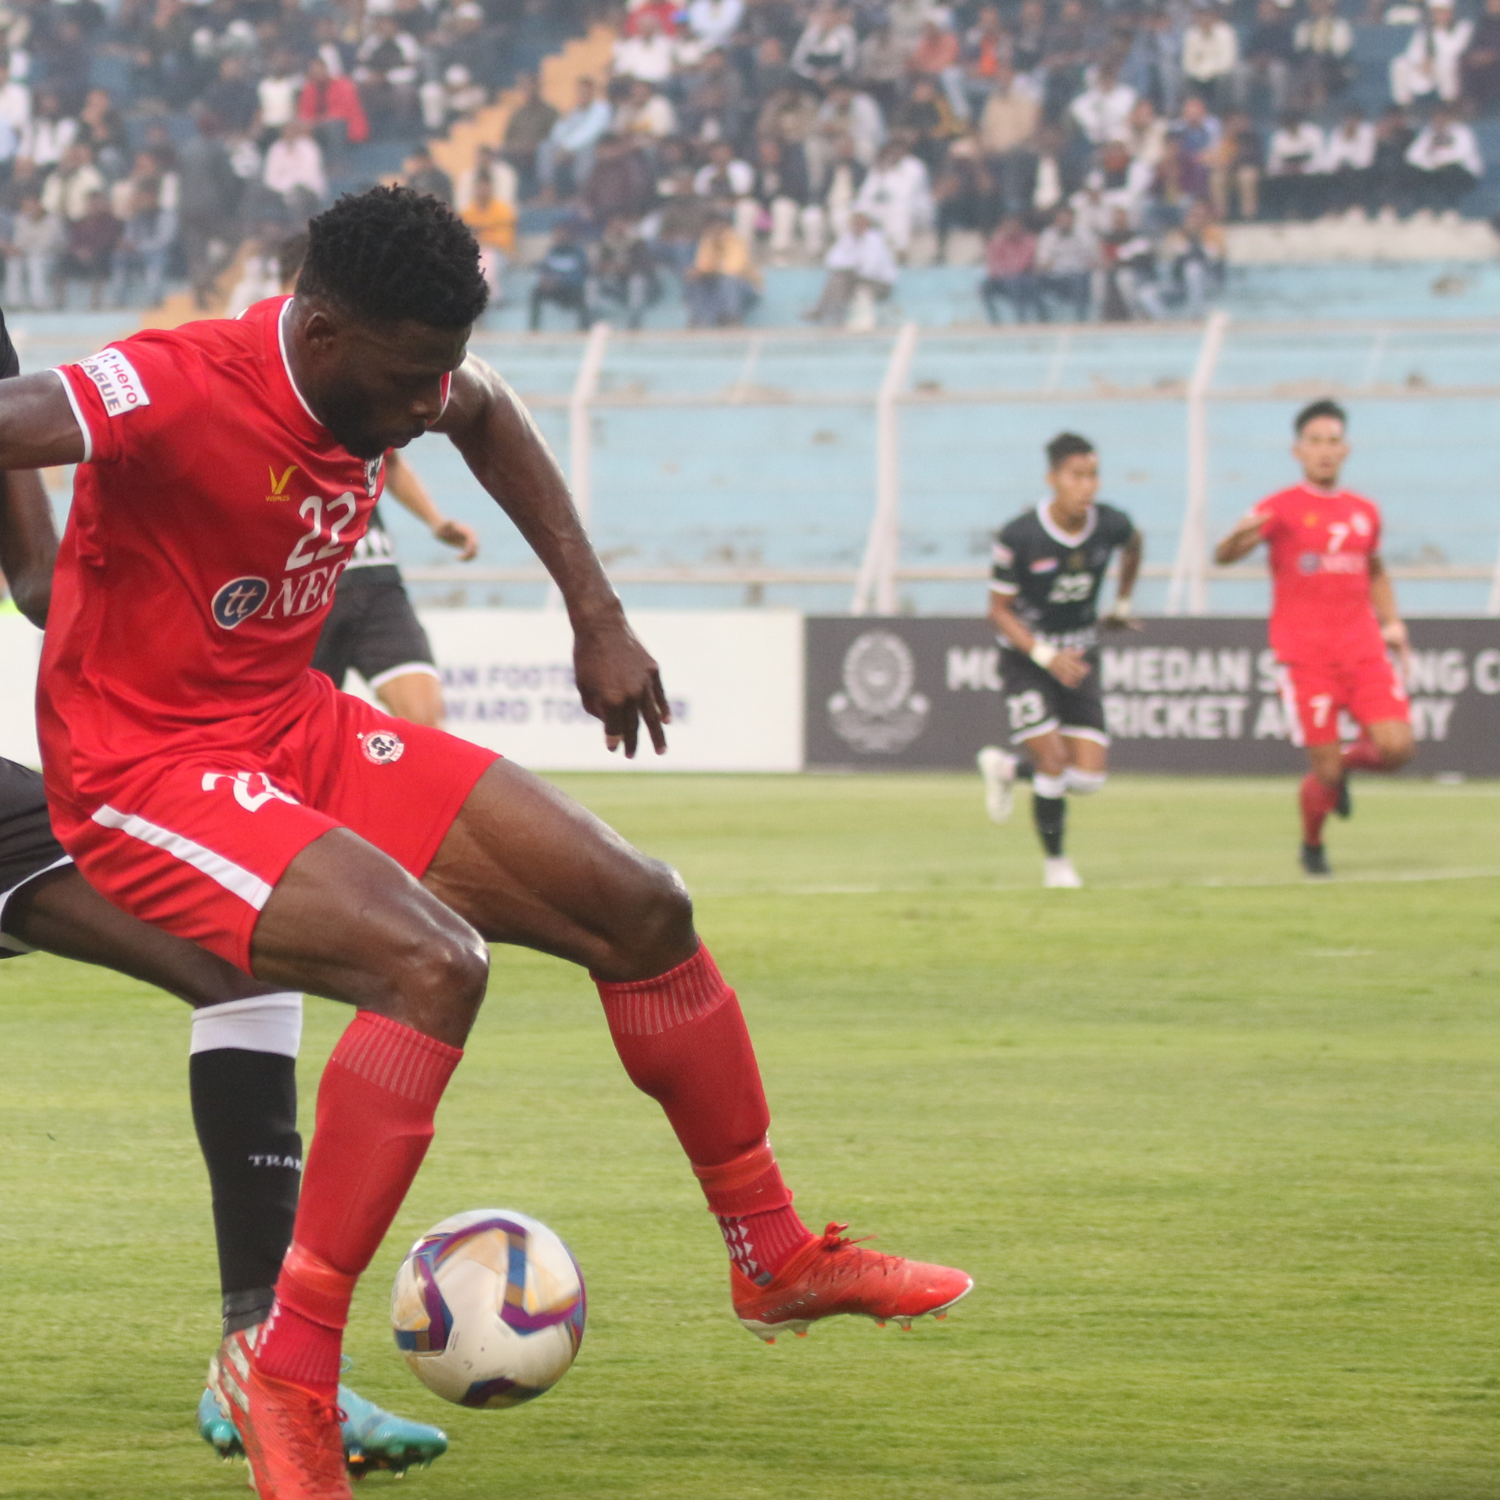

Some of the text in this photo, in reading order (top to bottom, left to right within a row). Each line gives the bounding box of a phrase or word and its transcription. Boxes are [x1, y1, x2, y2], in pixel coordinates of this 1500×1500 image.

[109, 363, 138, 405] Hero
[284, 490, 357, 572] 22
[1326, 521, 1350, 554] 7
[1309, 692, 1333, 728] 7
